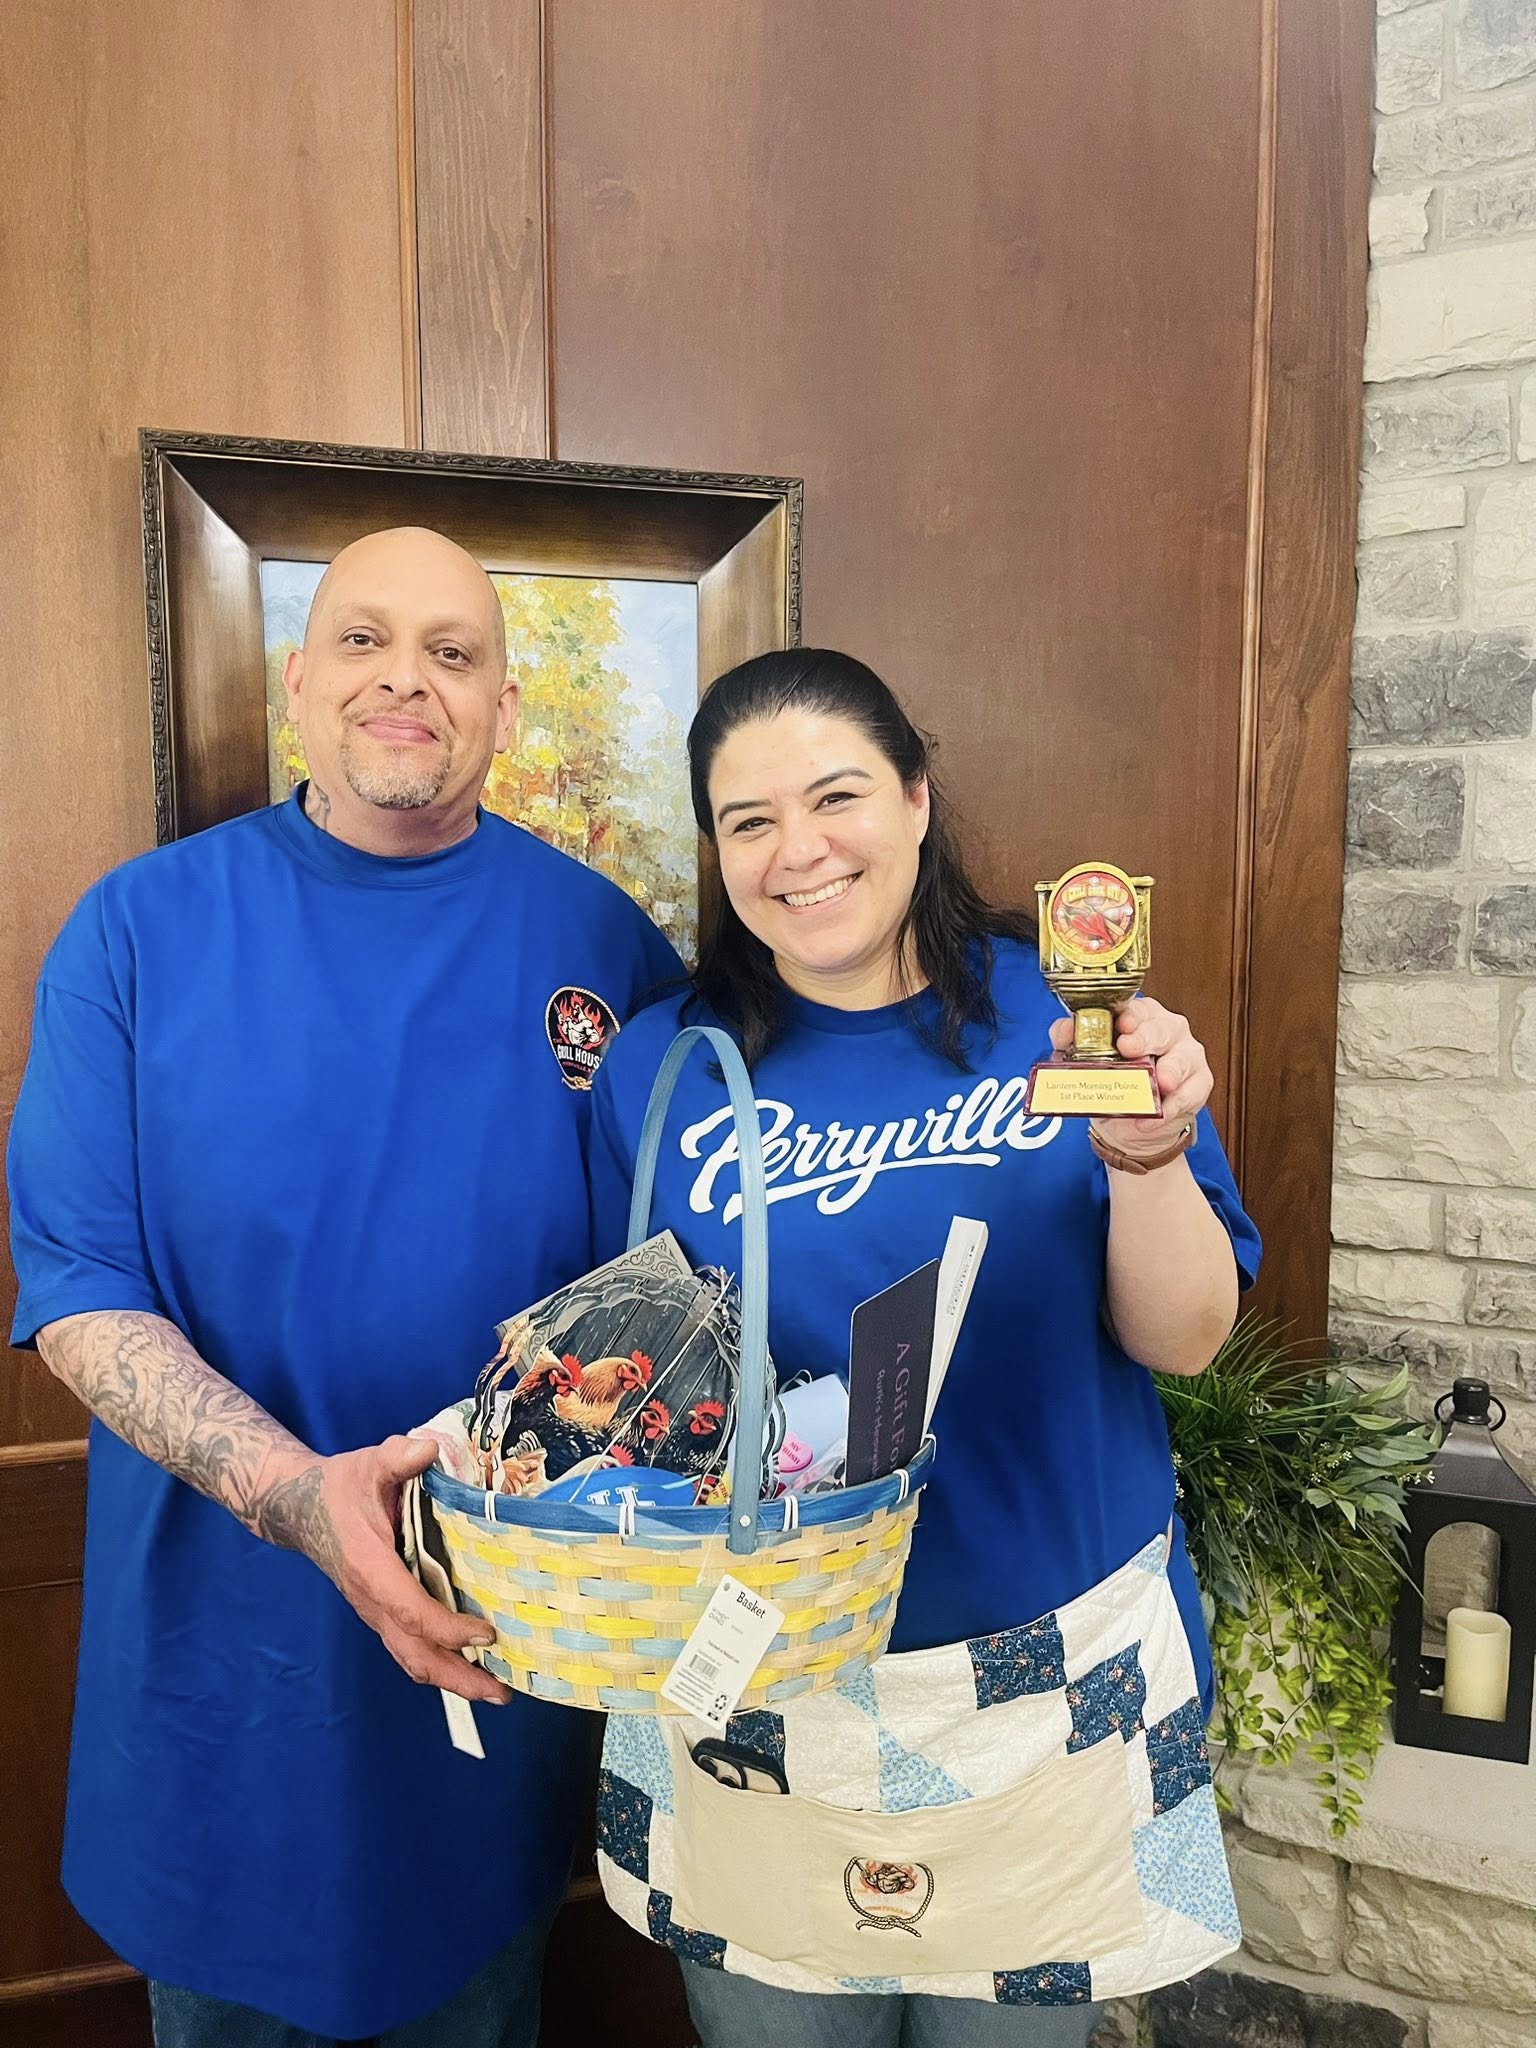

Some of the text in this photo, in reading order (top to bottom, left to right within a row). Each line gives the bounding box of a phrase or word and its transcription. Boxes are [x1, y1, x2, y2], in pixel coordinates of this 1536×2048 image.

[1046, 1081, 1139, 1091] Lantern Morning Pointe
[1060, 1092, 1125, 1100] 1st Place Winner
[680, 1077, 1062, 1225] Perryville
[896, 1342, 911, 1364] A
[893, 1368, 911, 1425] Gift
[736, 1591, 766, 1619] Basket
